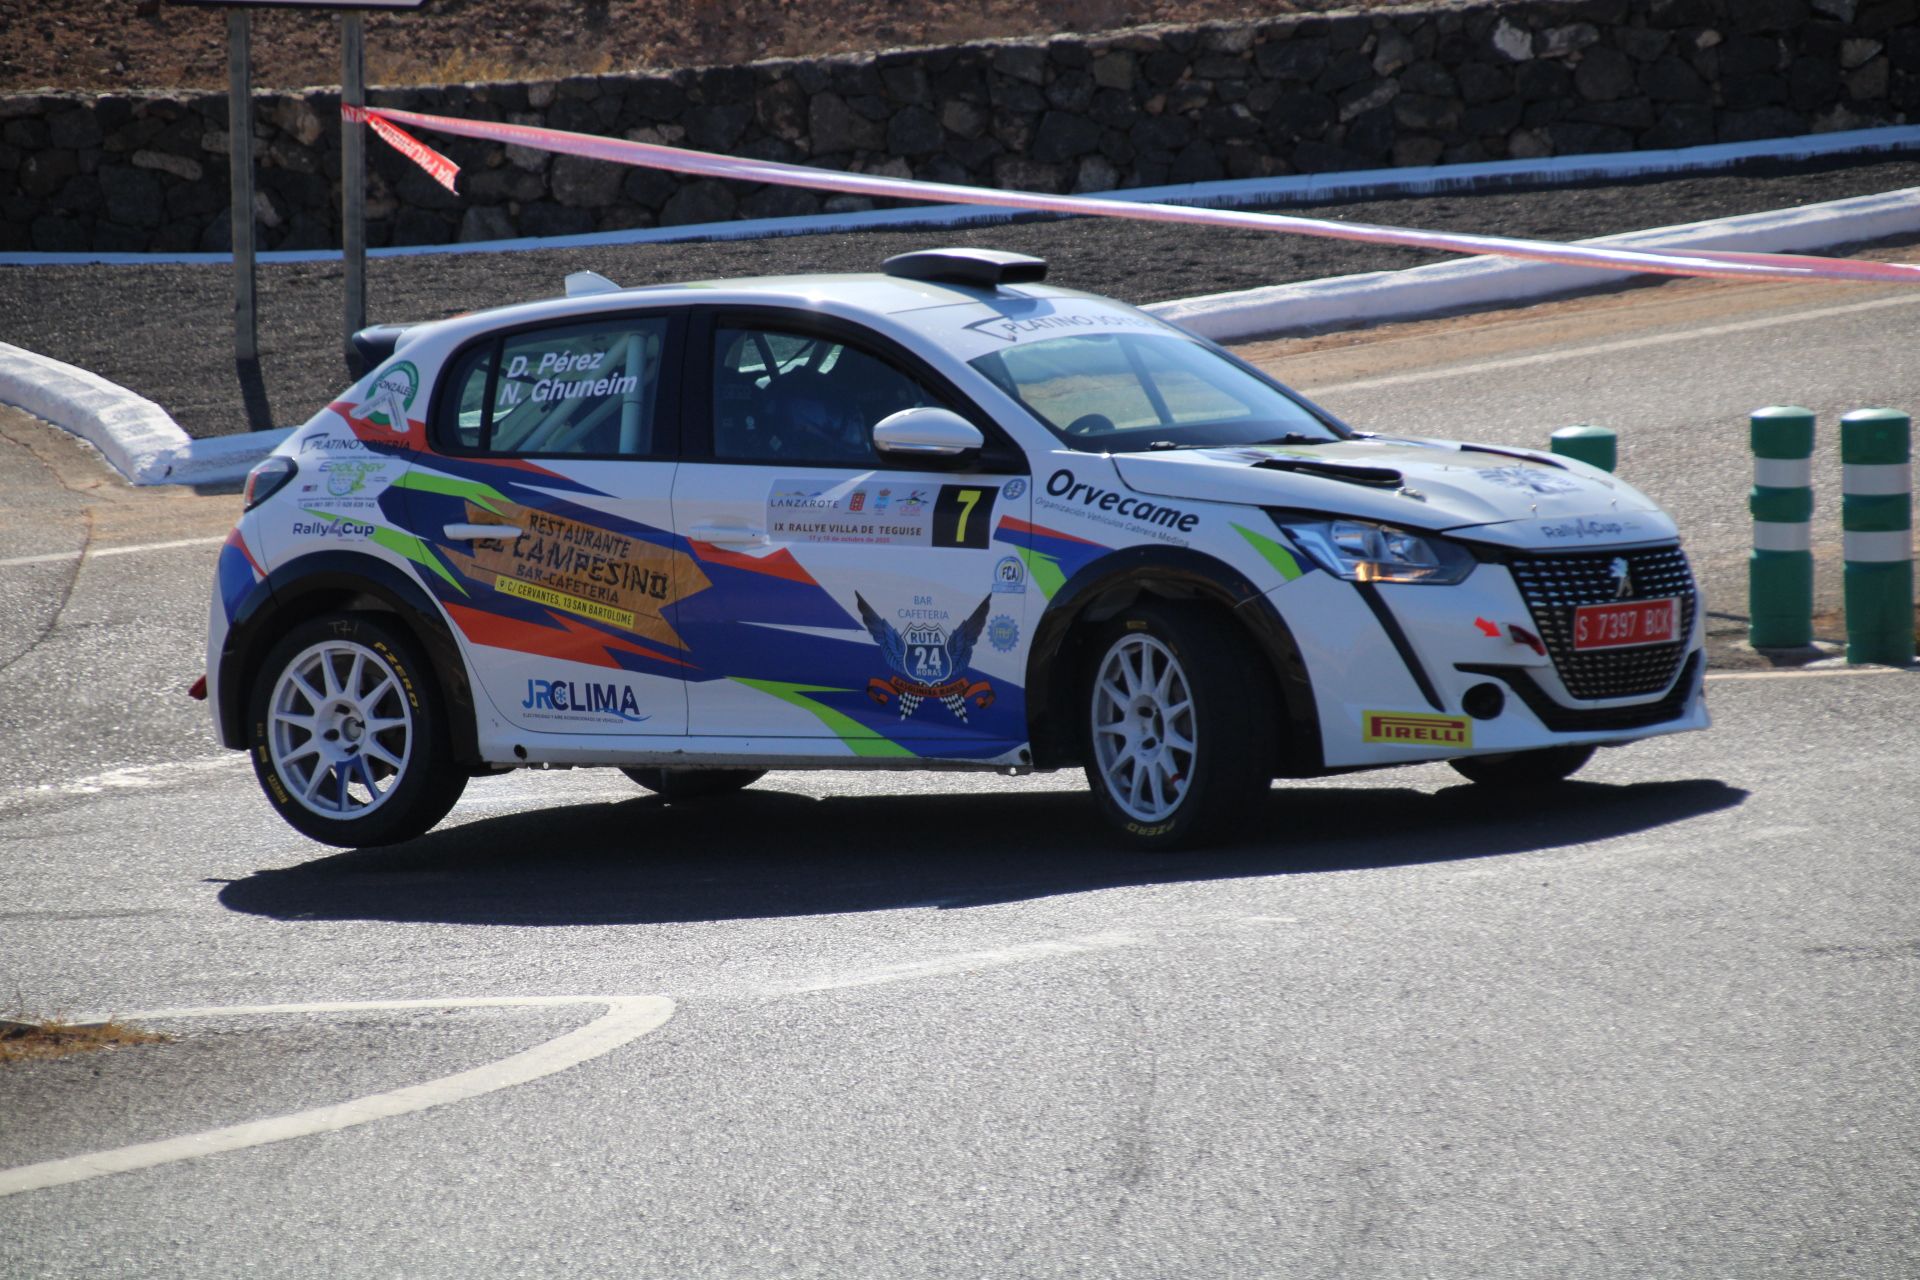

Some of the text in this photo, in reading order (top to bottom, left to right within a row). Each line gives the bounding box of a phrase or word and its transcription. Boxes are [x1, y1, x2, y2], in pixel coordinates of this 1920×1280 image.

[507, 350, 605, 378] D. Pérez
[499, 372, 638, 405] N. Ghuneim
[310, 438, 359, 450] PLATINO
[770, 498, 839, 509] LANZAROTE
[1046, 469, 1200, 533] Orvecame
[292, 518, 375, 536] Rally4Cup
[955, 489, 982, 543] 7
[528, 512, 632, 559] RESTAURANTE
[774, 522, 922, 536] IX RALLYE VILLA DE TEGUISE
[1125, 522, 1157, 539] Cabrera
[1158, 532, 1190, 548] Medina
[513, 531, 669, 600] CAMPESINO
[1001, 565, 1019, 581] FCA
[507, 580, 518, 593] C/
[563, 596, 572, 608] 13
[571, 598, 588, 613] SAN
[914, 595, 933, 606] BAR
[897, 608, 951, 620] CAFETERIA
[1578, 615, 1589, 642] S
[1599, 610, 1638, 640] 7397
[910, 632, 941, 644] RUTA
[914, 646, 942, 670] 24
[916, 668, 943, 677] HORAS
[1370, 716, 1466, 743] PIRELLI
